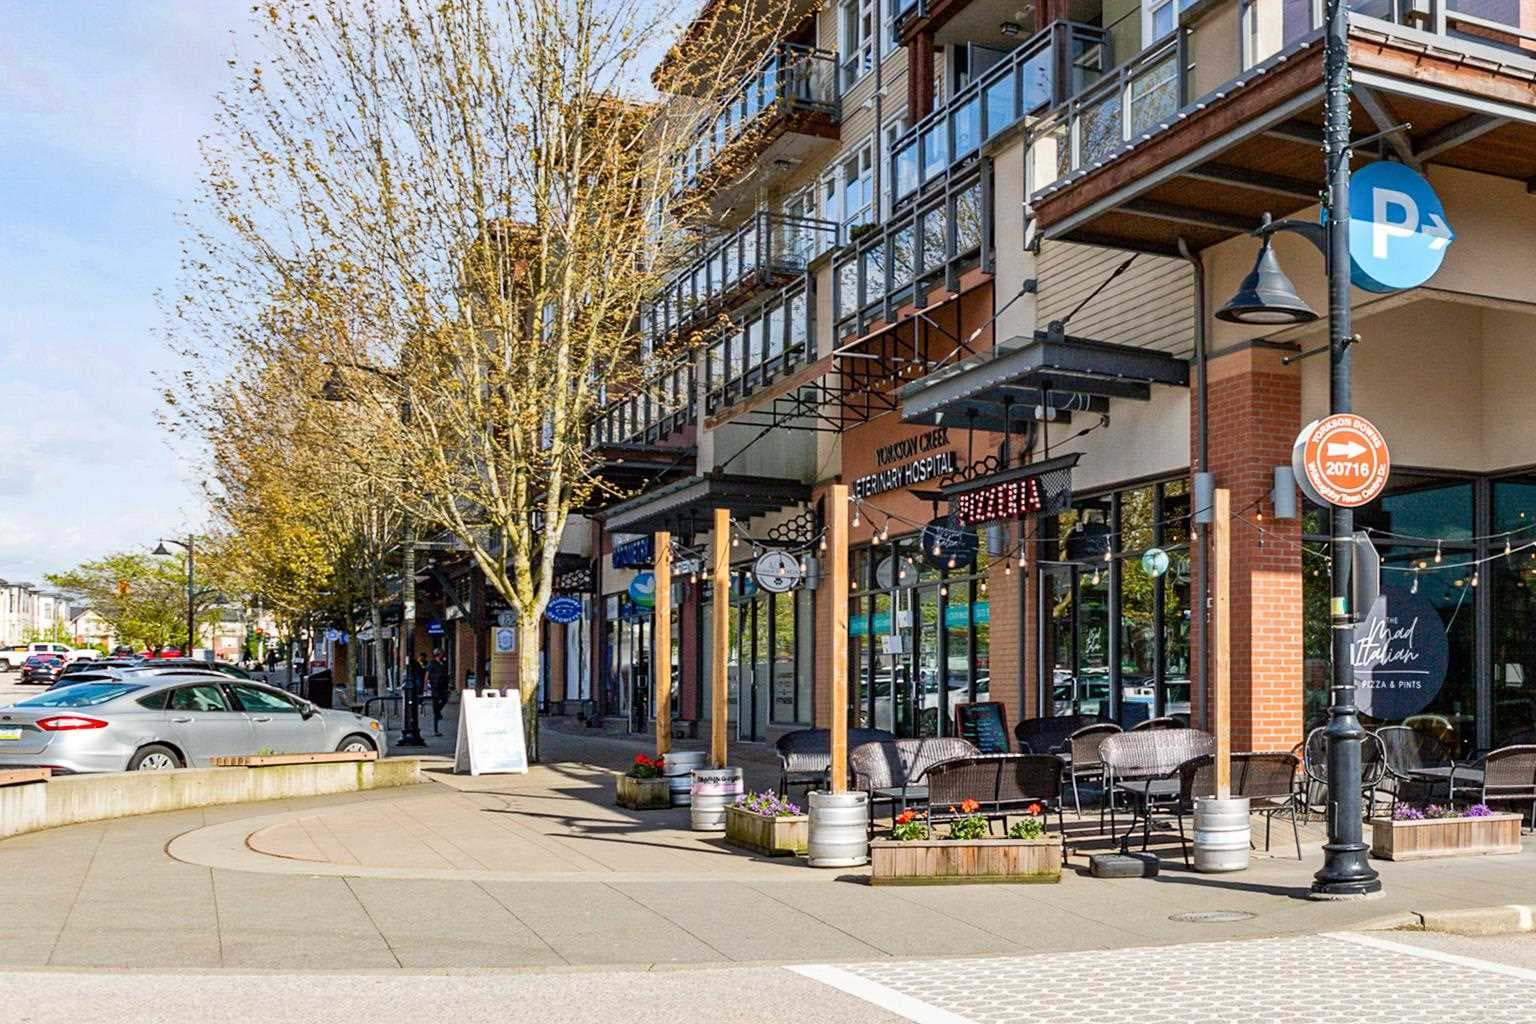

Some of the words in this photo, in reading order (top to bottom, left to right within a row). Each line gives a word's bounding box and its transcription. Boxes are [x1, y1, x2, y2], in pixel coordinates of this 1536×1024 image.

[1373, 187, 1419, 260] P
[919, 426, 950, 453] CREEK
[1353, 419, 1382, 449] DOWNS
[904, 451, 954, 484] HOSPITAL
[1326, 461, 1370, 477] 20716
[1367, 617, 1418, 648] Mad
[1354, 637, 1419, 666] Italian
[1389, 680, 1395, 689] &
[1398, 680, 1422, 689] PINTS
